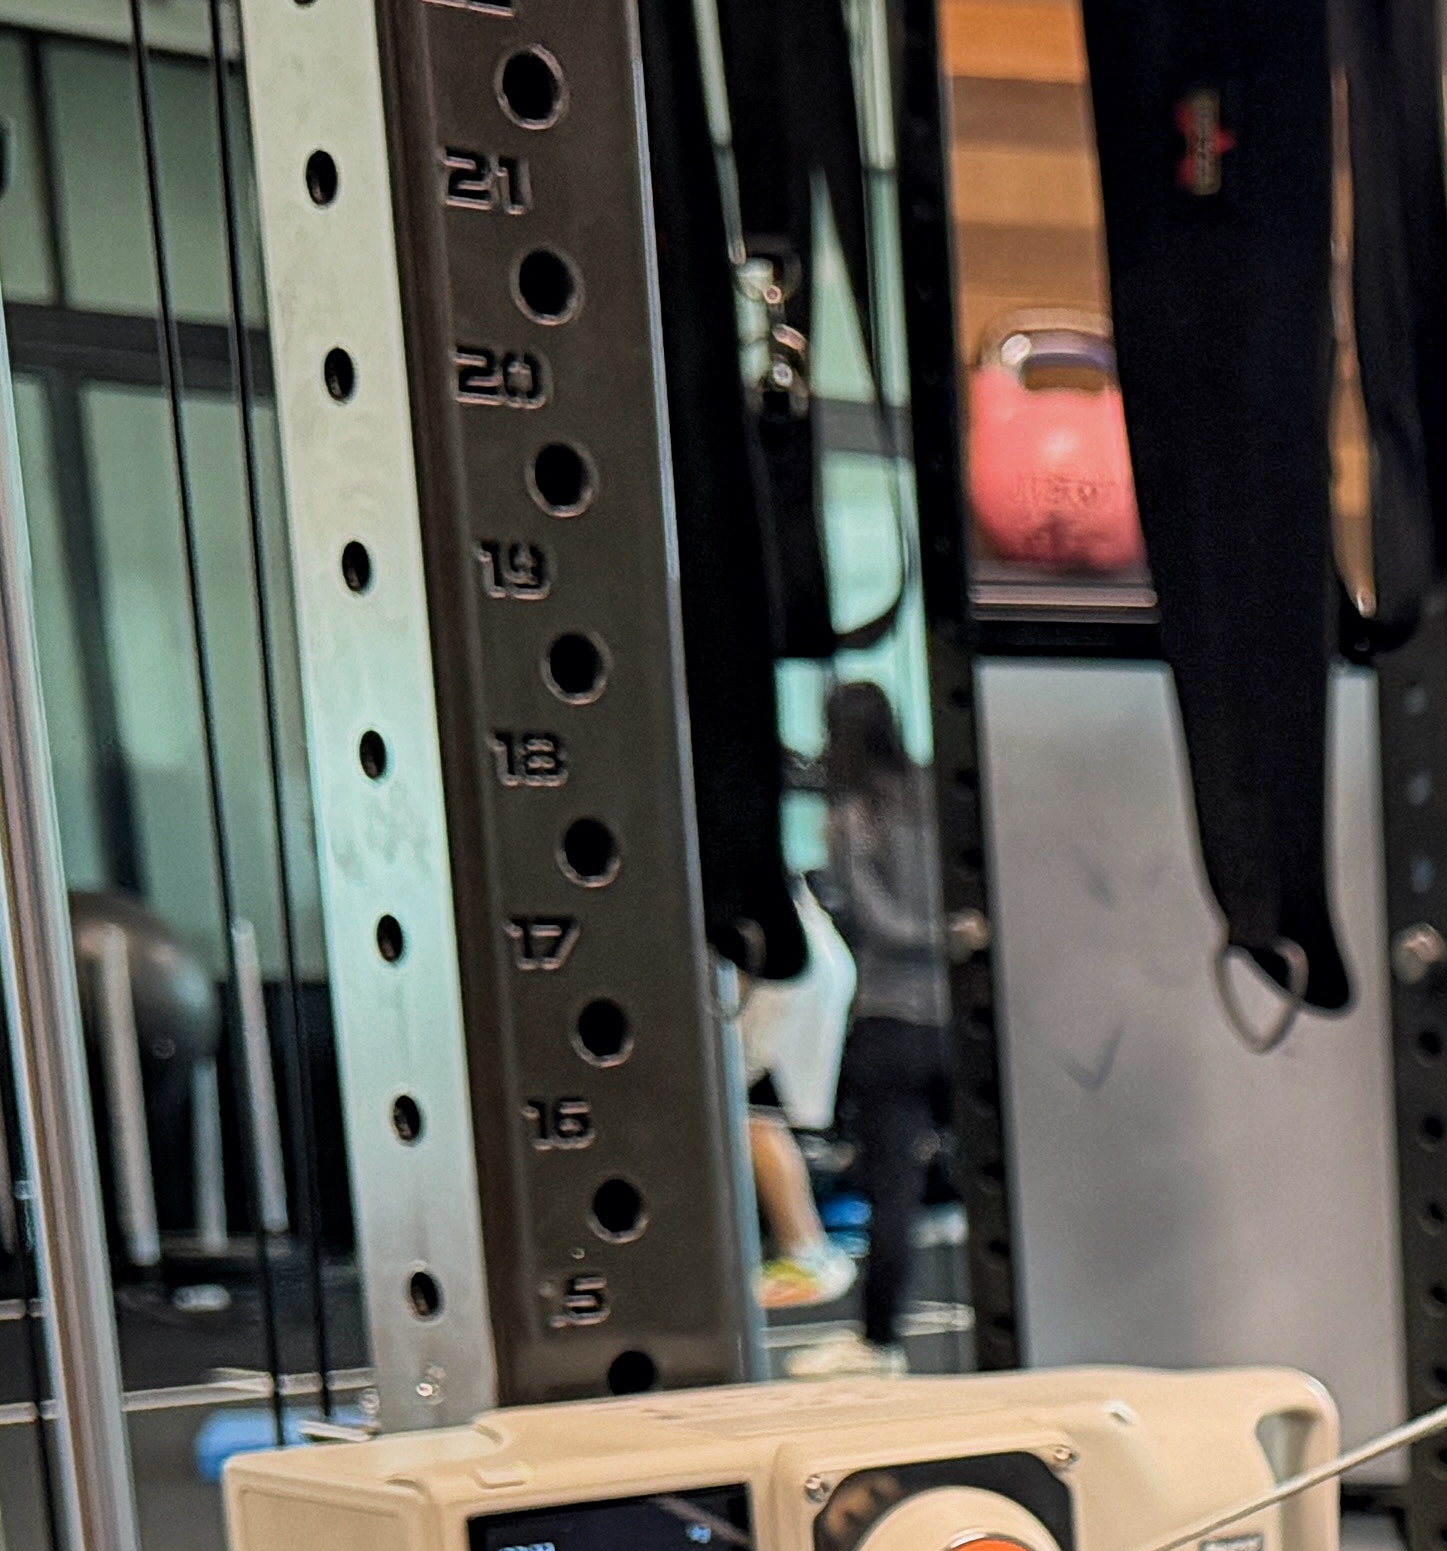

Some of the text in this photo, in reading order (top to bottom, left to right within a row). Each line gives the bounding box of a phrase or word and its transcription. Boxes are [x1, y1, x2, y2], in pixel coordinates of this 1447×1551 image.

[443, 145, 531, 215] 21
[453, 346, 552, 408] 20
[476, 540, 550, 600] 19
[491, 731, 569, 788] 18
[506, 915, 580, 971] 17
[520, 1100, 596, 1151] 16
